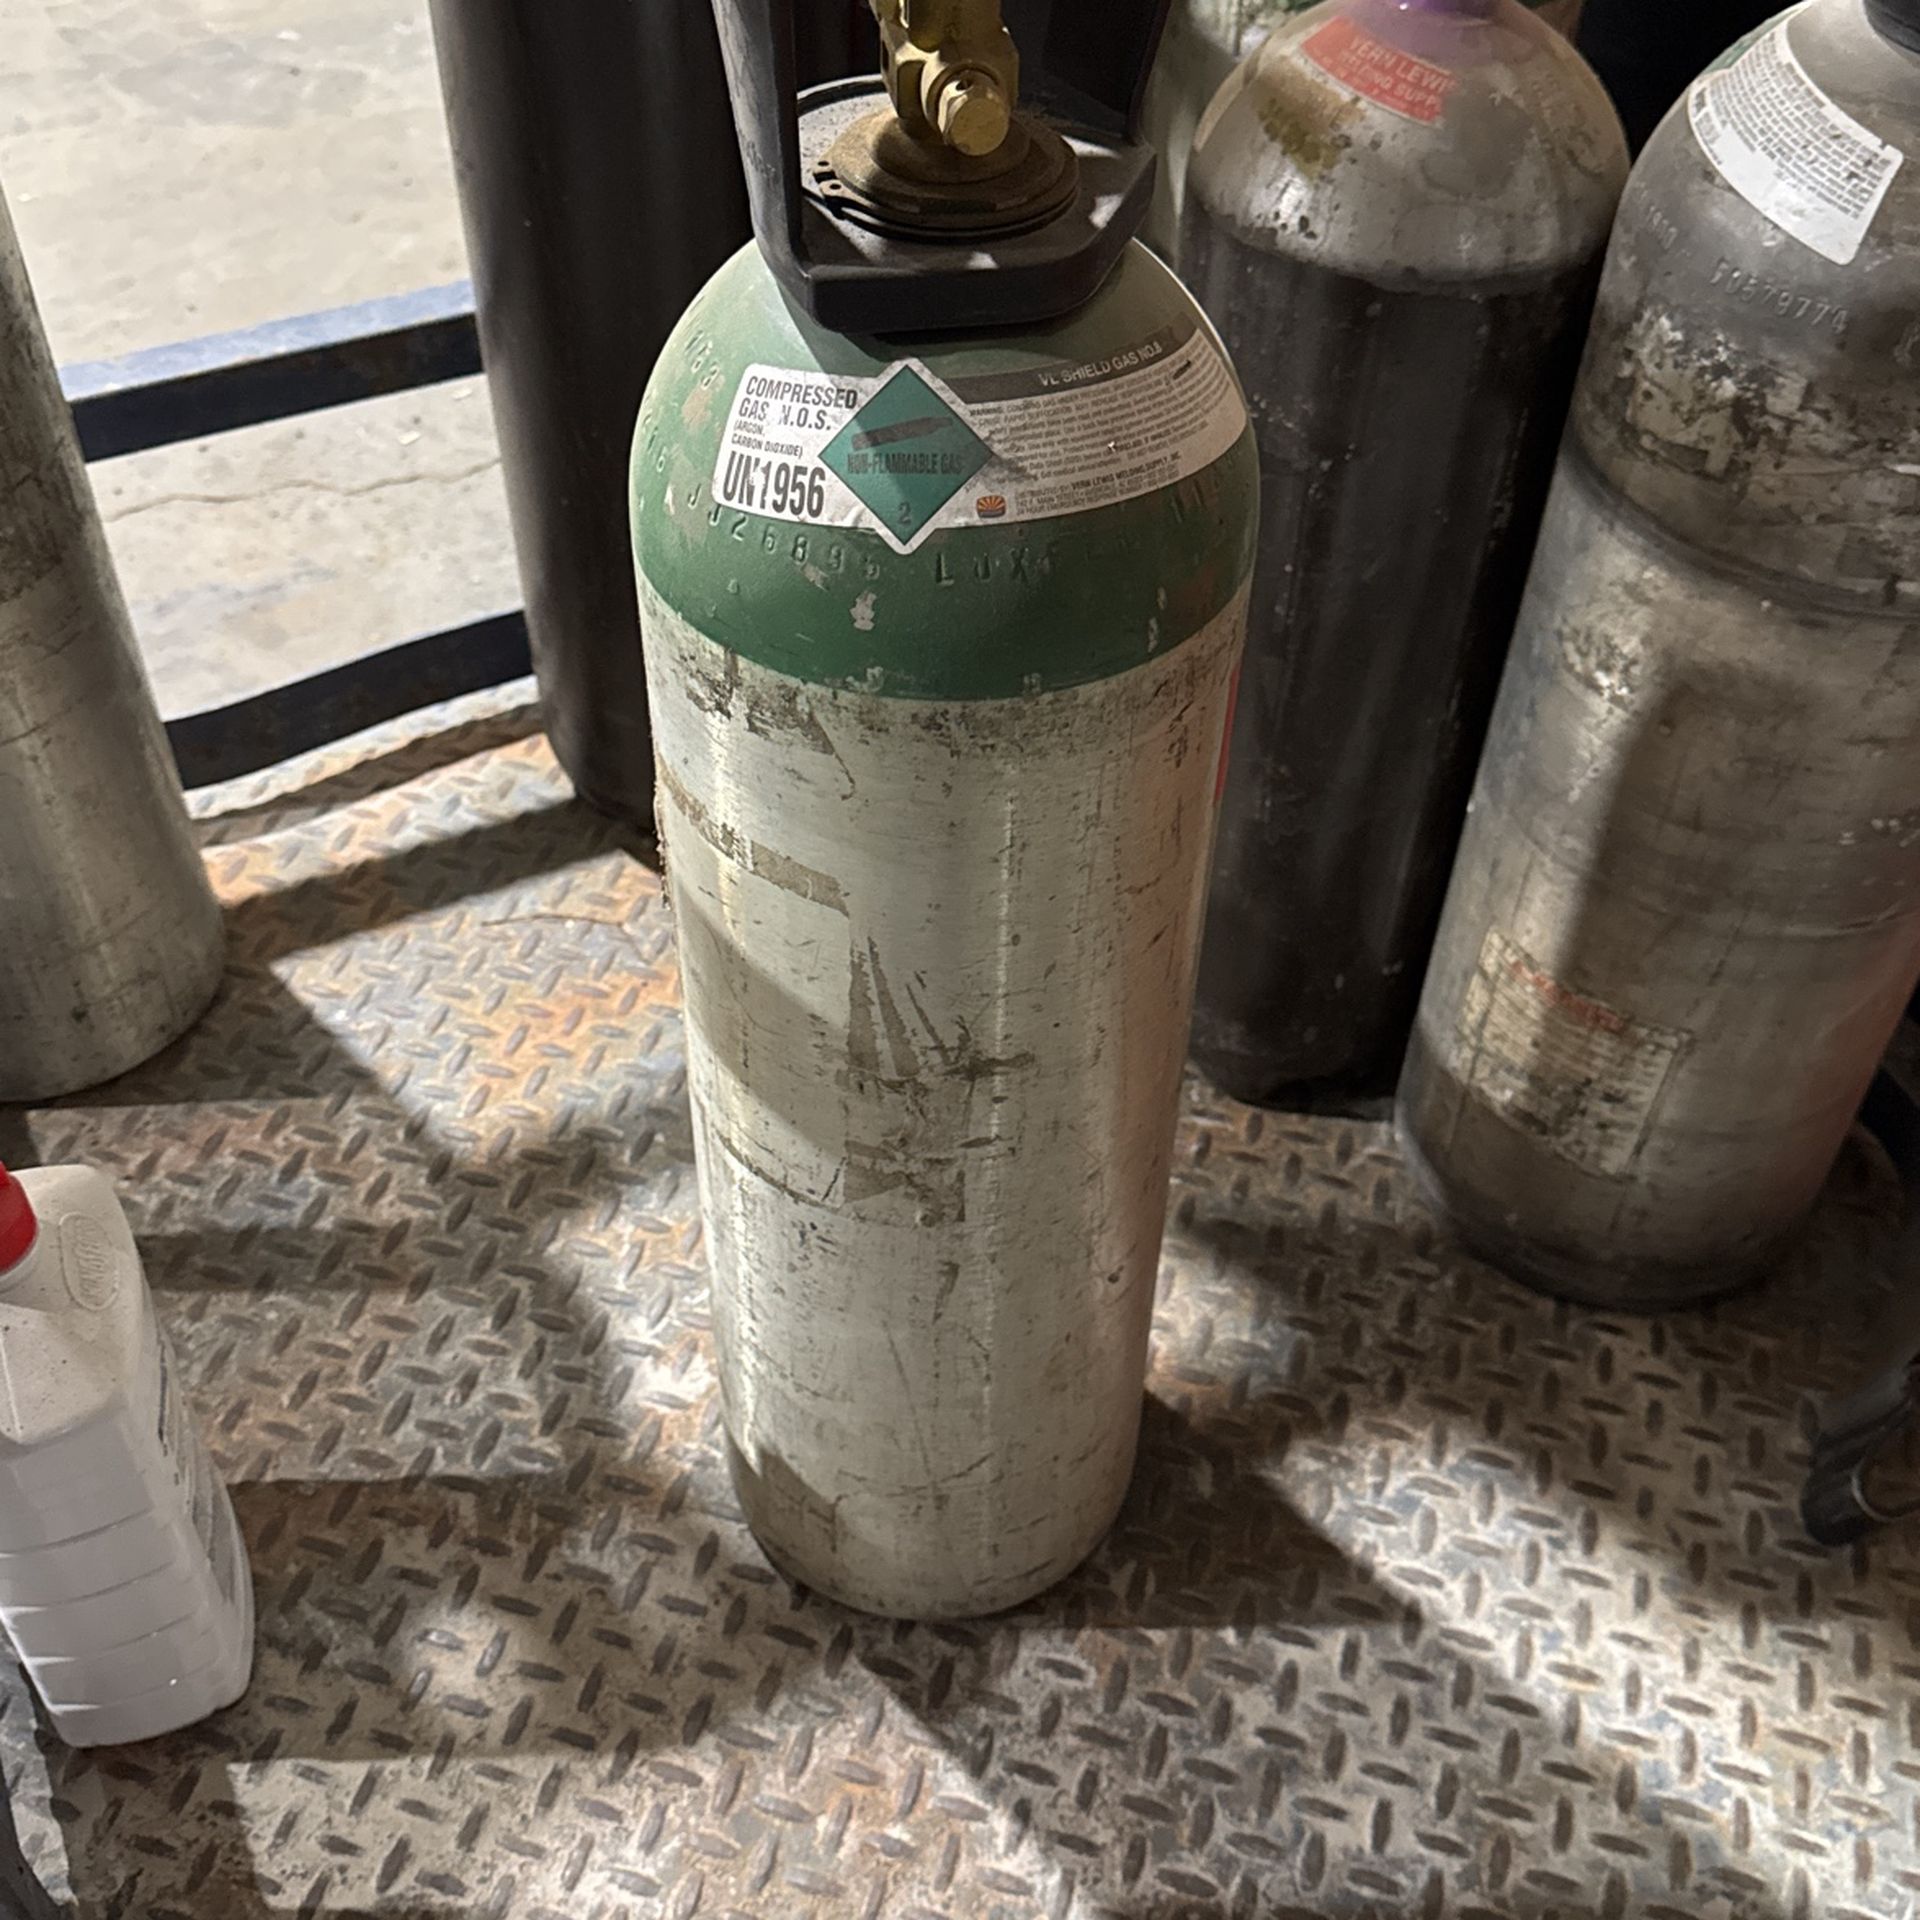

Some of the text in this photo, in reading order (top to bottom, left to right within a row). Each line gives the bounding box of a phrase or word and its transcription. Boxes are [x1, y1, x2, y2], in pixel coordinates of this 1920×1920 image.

[1060, 360, 1111, 383] SHIELD
[1111, 352, 1140, 370] GAS
[745, 375, 859, 410] COMPRESSED
[731, 433, 763, 451] CARBON
[722, 450, 827, 519] UN1956
[897, 502, 913, 524] 2
